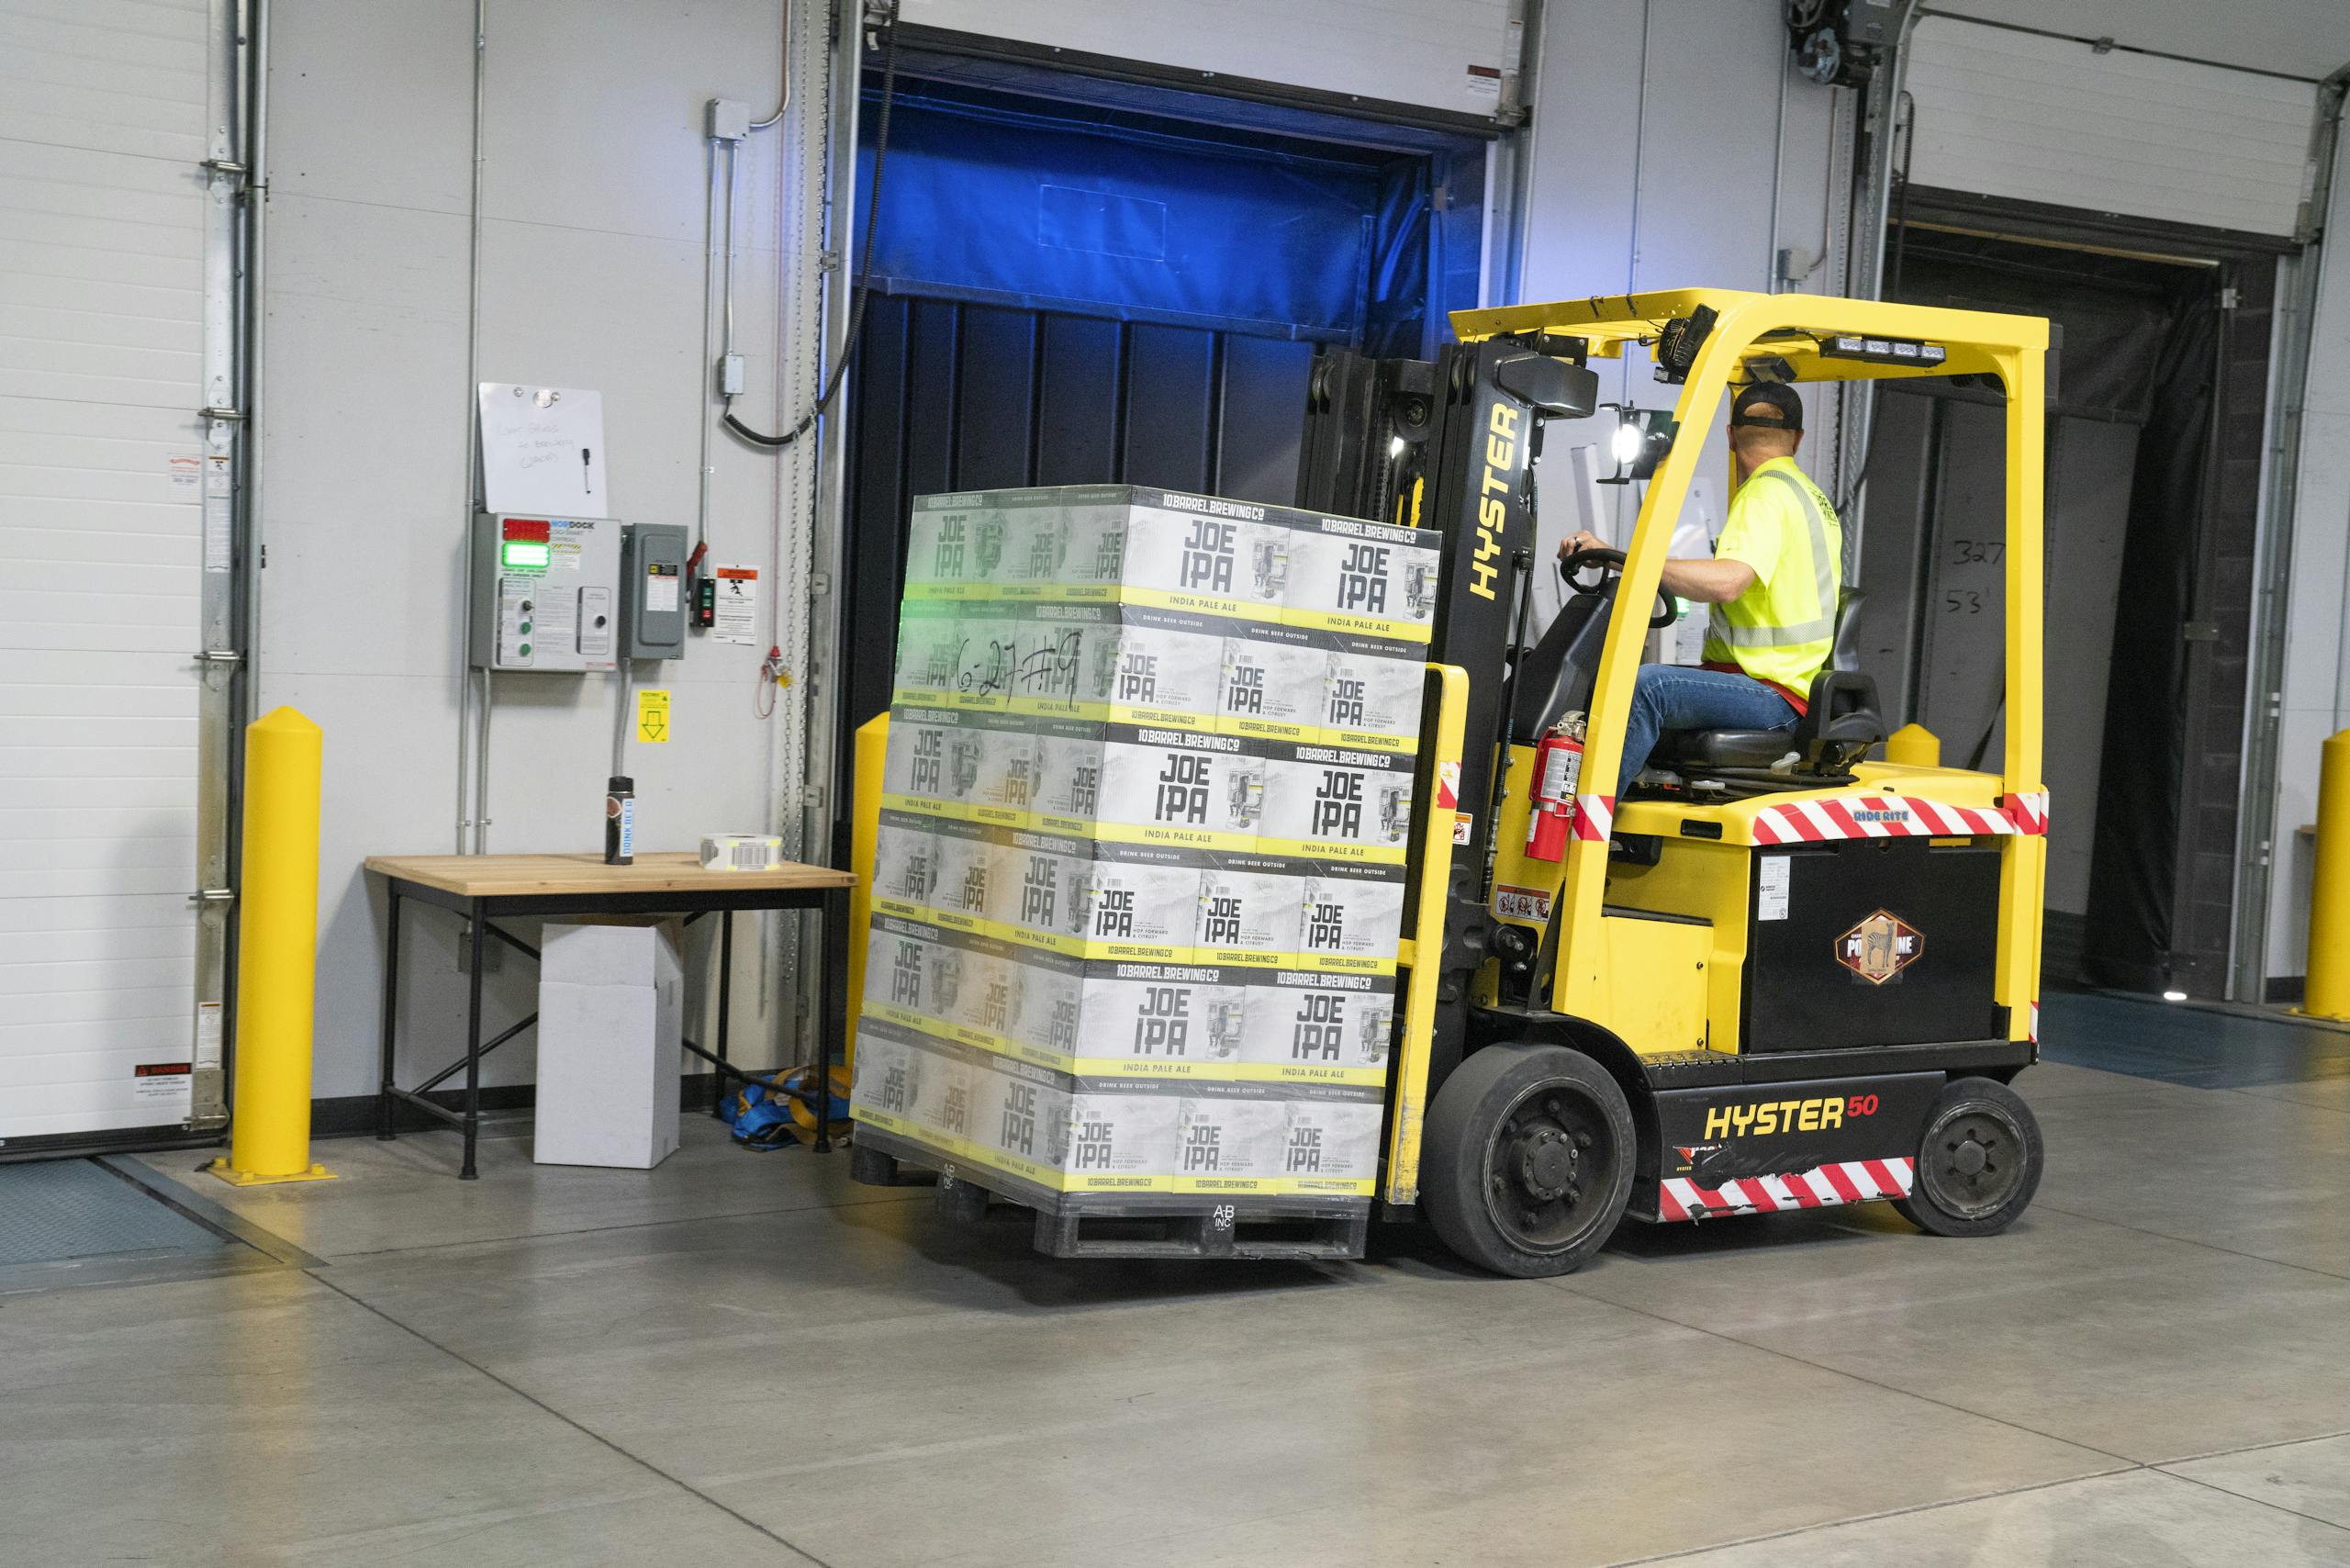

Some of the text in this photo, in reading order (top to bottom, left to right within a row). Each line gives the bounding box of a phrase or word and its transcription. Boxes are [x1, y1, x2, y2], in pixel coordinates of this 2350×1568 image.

[1470, 402, 1518, 601] HYSTER
[939, 515, 967, 542] JOE
[1185, 520, 1237, 554] JOE
[1098, 532, 1123, 553] JOE
[1953, 540, 2006, 565] 327
[934, 544, 964, 577] IPA
[1095, 554, 1120, 578] IPA
[1180, 552, 1234, 594] IPA
[1342, 543, 1390, 577] JOE
[1170, 596, 1237, 611] INDIA PALE ALE
[1337, 573, 1387, 613] IPA
[1180, 619, 1203, 627] OUTSIDE
[1327, 617, 1350, 626] INDIA
[1355, 621, 1372, 629] PALE
[1122, 654, 1158, 676] JOE
[1231, 666, 1265, 688] JOE
[1119, 675, 1155, 702] IPA
[1228, 687, 1262, 713] IPA
[1333, 679, 1365, 700] JOE
[1330, 700, 1363, 726] IPA
[914, 730, 943, 757] JOE
[911, 757, 940, 793] IPA
[1007, 759, 1029, 779] JOE
[1073, 767, 1096, 788] JOE
[1160, 754, 1212, 786] JOE
[1005, 779, 1027, 805] IPA
[1316, 770, 1364, 801] JOE
[1070, 788, 1095, 814] IPA
[1156, 784, 1208, 823] IPA
[1312, 801, 1361, 838] IPA
[1853, 811, 1908, 822] RIDE RITE
[1146, 830, 1169, 839] INDIA
[1174, 833, 1193, 841] PALE
[1303, 845, 1326, 853] INDIA
[1329, 846, 1348, 855] PALE
[907, 856, 926, 876] JOE
[965, 867, 986, 887] JOE
[1025, 857, 1058, 889] JOE
[905, 875, 924, 900] IPA
[963, 886, 984, 912] IPA
[1099, 890, 1134, 911] JOE
[1021, 886, 1055, 926] IPA
[1208, 898, 1241, 918] JOE
[1312, 904, 1344, 924] JOE
[1096, 911, 1132, 937] IPA
[1205, 918, 1239, 944] IPA
[1308, 924, 1341, 949] IPA
[1015, 930, 1056, 945] INDIA PALE ALE
[895, 941, 923, 972] JOE
[892, 969, 920, 1007] IPA
[1053, 1000, 1076, 1024] JOE
[1139, 987, 1191, 1017] JOE
[1297, 994, 1346, 1024] JOE
[1049, 1021, 1073, 1050] IPA
[1135, 1018, 1188, 1055] IPA
[1292, 1025, 1342, 1060] IPA
[1282, 1068, 1305, 1076] INDIA
[1004, 1081, 1036, 1117] JOE
[1704, 1093, 1878, 1140] HYSTER 50
[1002, 1111, 1034, 1155] IPA
[1079, 1123, 1113, 1142] JOE
[1187, 1126, 1221, 1145] JOE
[1290, 1128, 1322, 1147] JOE
[1075, 1144, 1112, 1168] IPA
[1184, 1147, 1219, 1170] IPA
[1287, 1148, 1320, 1172] IPA
[1214, 1218, 1231, 1227] INC
